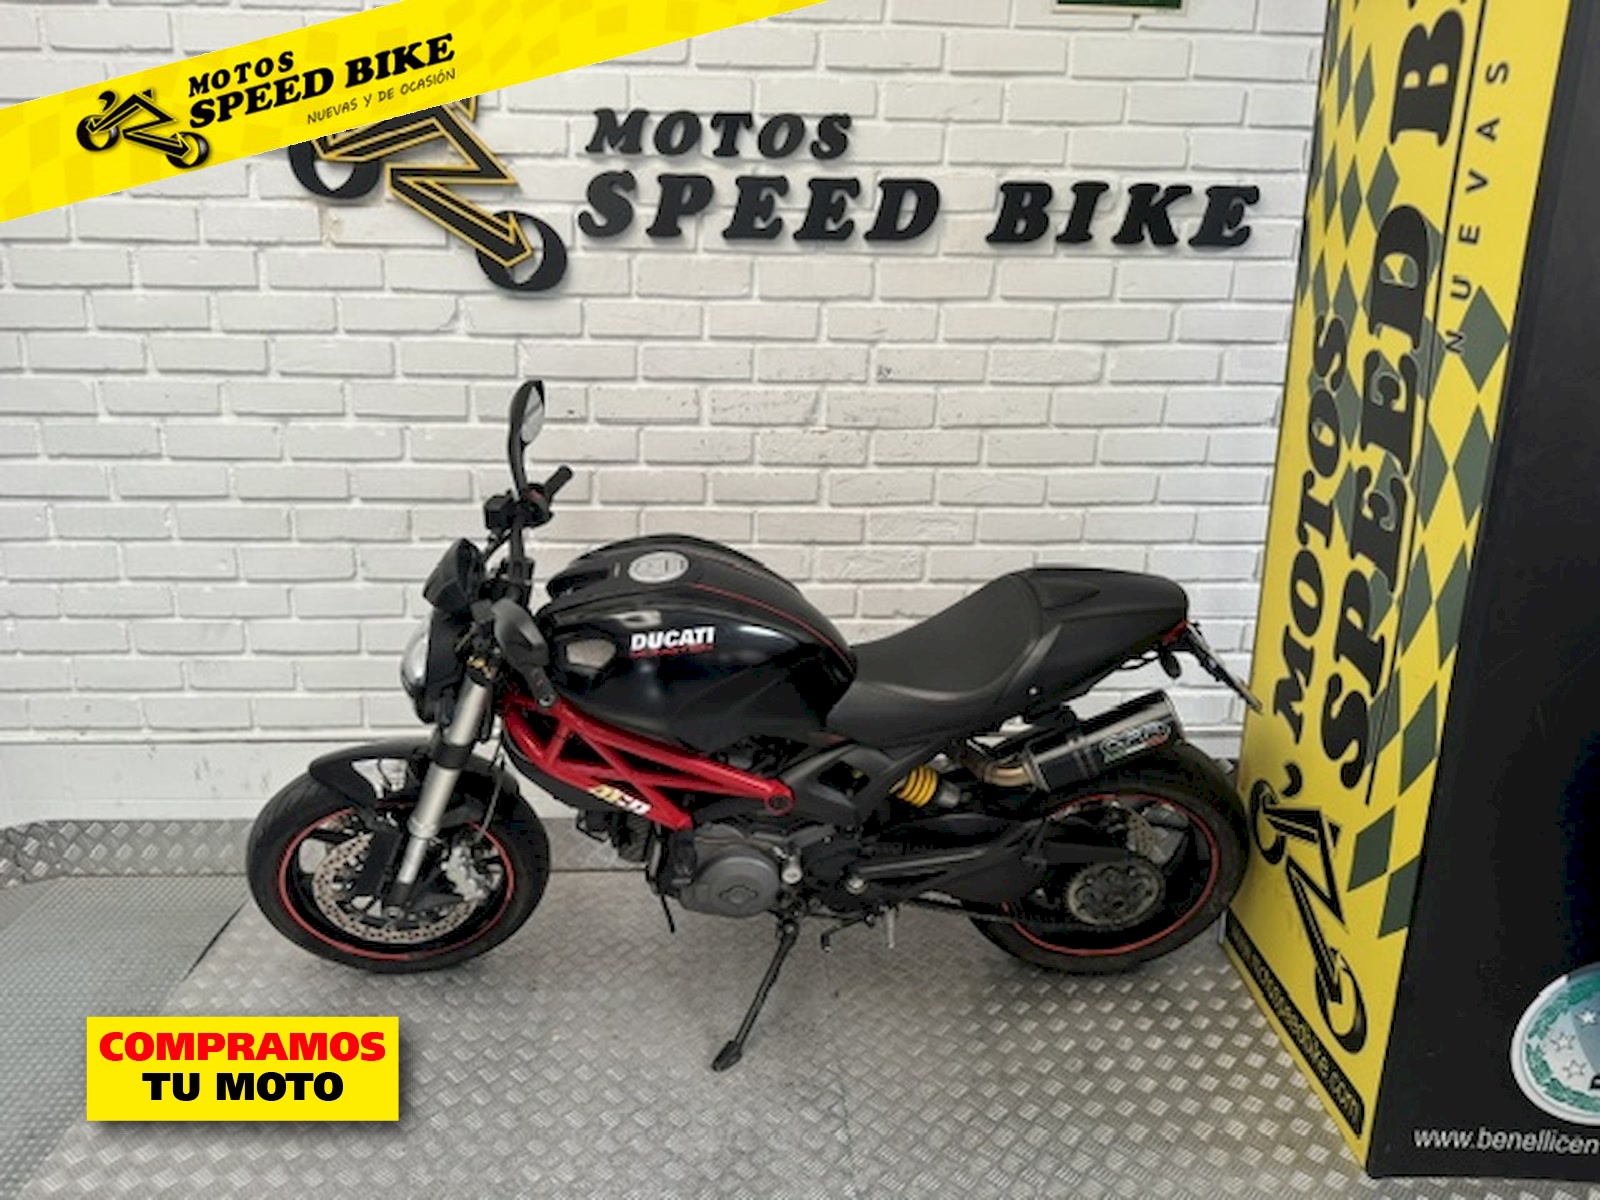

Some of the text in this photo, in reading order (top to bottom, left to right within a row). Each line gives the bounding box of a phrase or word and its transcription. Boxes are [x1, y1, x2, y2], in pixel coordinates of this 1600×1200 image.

[578, 171, 1261, 248] SPEED BIKE
[585, 109, 852, 160] MOTOS
[1444, 60, 1510, 354] NUEVAS
[1320, 0, 1465, 790] SPEED B
[1273, 314, 1348, 744] MOTOS
[630, 626, 716, 651] DUCATI
